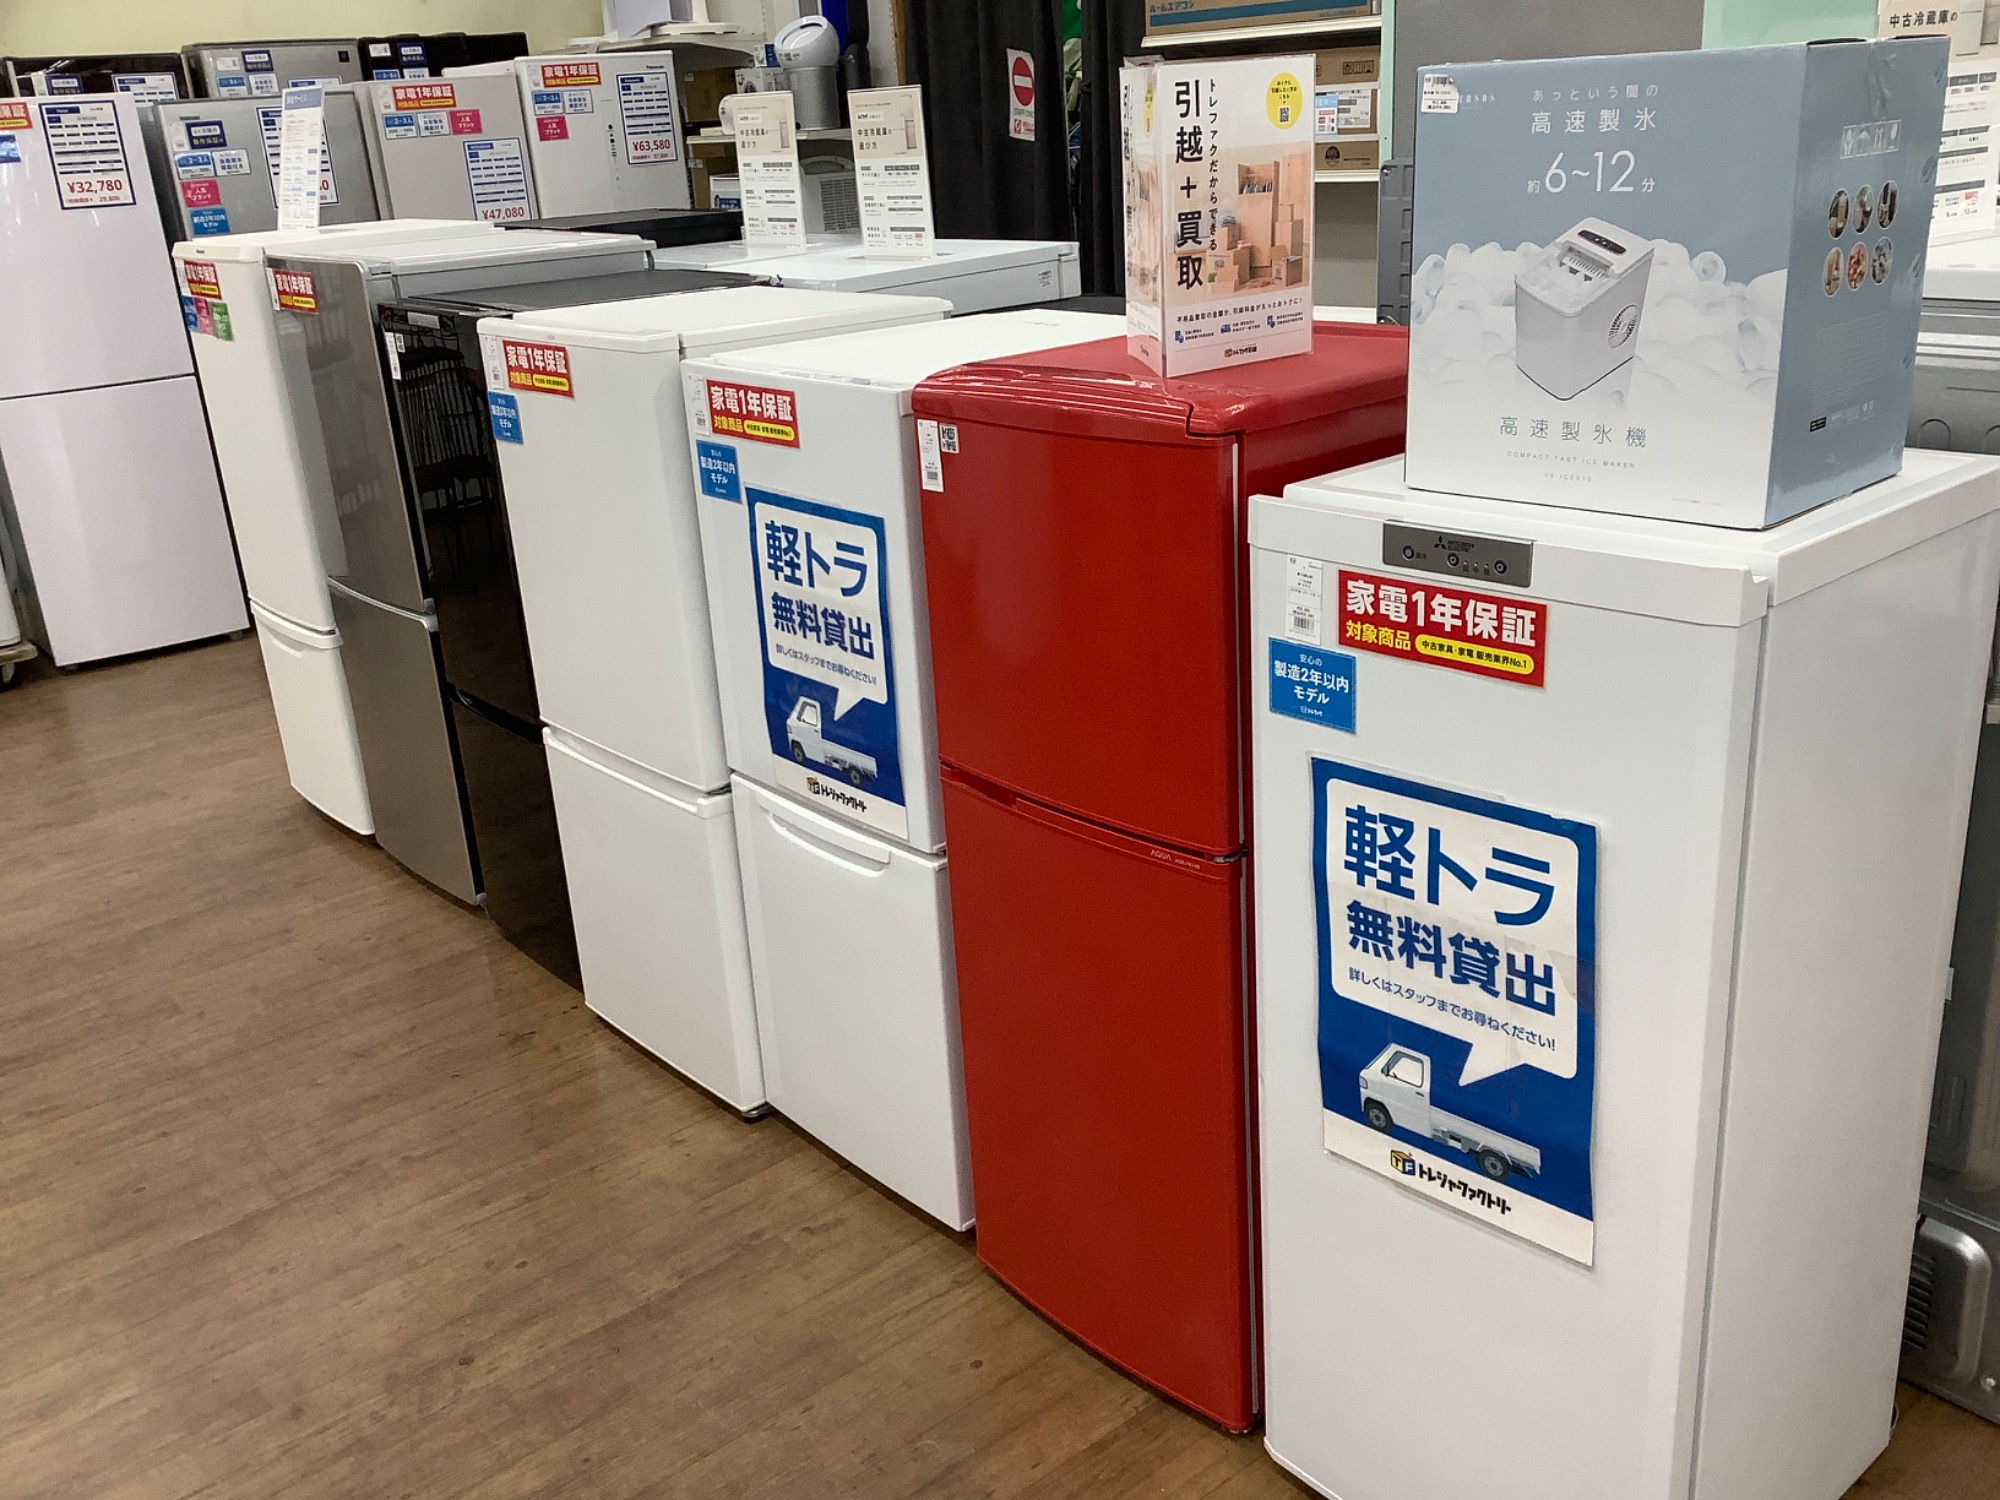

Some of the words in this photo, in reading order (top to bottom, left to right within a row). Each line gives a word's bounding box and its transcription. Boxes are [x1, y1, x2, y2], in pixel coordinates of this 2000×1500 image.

[1890, 9, 1958, 28] 中古冷蔵庫の
[544, 64, 598, 78] 家電1年保証
[395, 85, 453, 100] 家電1年保証
[1532, 84, 1659, 102] あっという間の
[1531, 107, 1657, 135] 高速製氷
[632, 139, 671, 152] ¥63,580
[1208, 78, 1219, 251] トレファクだからできる
[1527, 149, 1656, 194] 約6~12分
[67, 179, 123, 194] ¥32,780
[1174, 79, 1203, 290] 引越+買取
[482, 206, 525, 221] ¥47,080
[505, 345, 568, 374] 家電1年保証
[710, 386, 794, 422] 家電1年保証
[714, 414, 744, 433] 対象商品
[1500, 415, 1647, 448] 高速製氷機
[1507, 450, 1550, 460] COMPACT
[1554, 455, 1577, 463] FAST
[1602, 460, 1636, 469] MAKER
[710, 472, 728, 485] モデル
[764, 520, 868, 598] 軽トラ
[771, 591, 875, 660] 無料貸出
[1345, 579, 1537, 648] 家電1年保証
[1345, 619, 1412, 651] 対象商品
[1299, 653, 1323, 667] 安心の
[1274, 660, 1350, 693] 製造2年以内
[1294, 684, 1330, 705] モデル
[1344, 804, 1556, 927] 軽トラ
[1346, 900, 1556, 1017] 無料貸出
[1348, 966, 1557, 1052] 詳しくはスタッフまでお尋ねください!
[1418, 1163, 1512, 1216] トレジャーファクトリー
